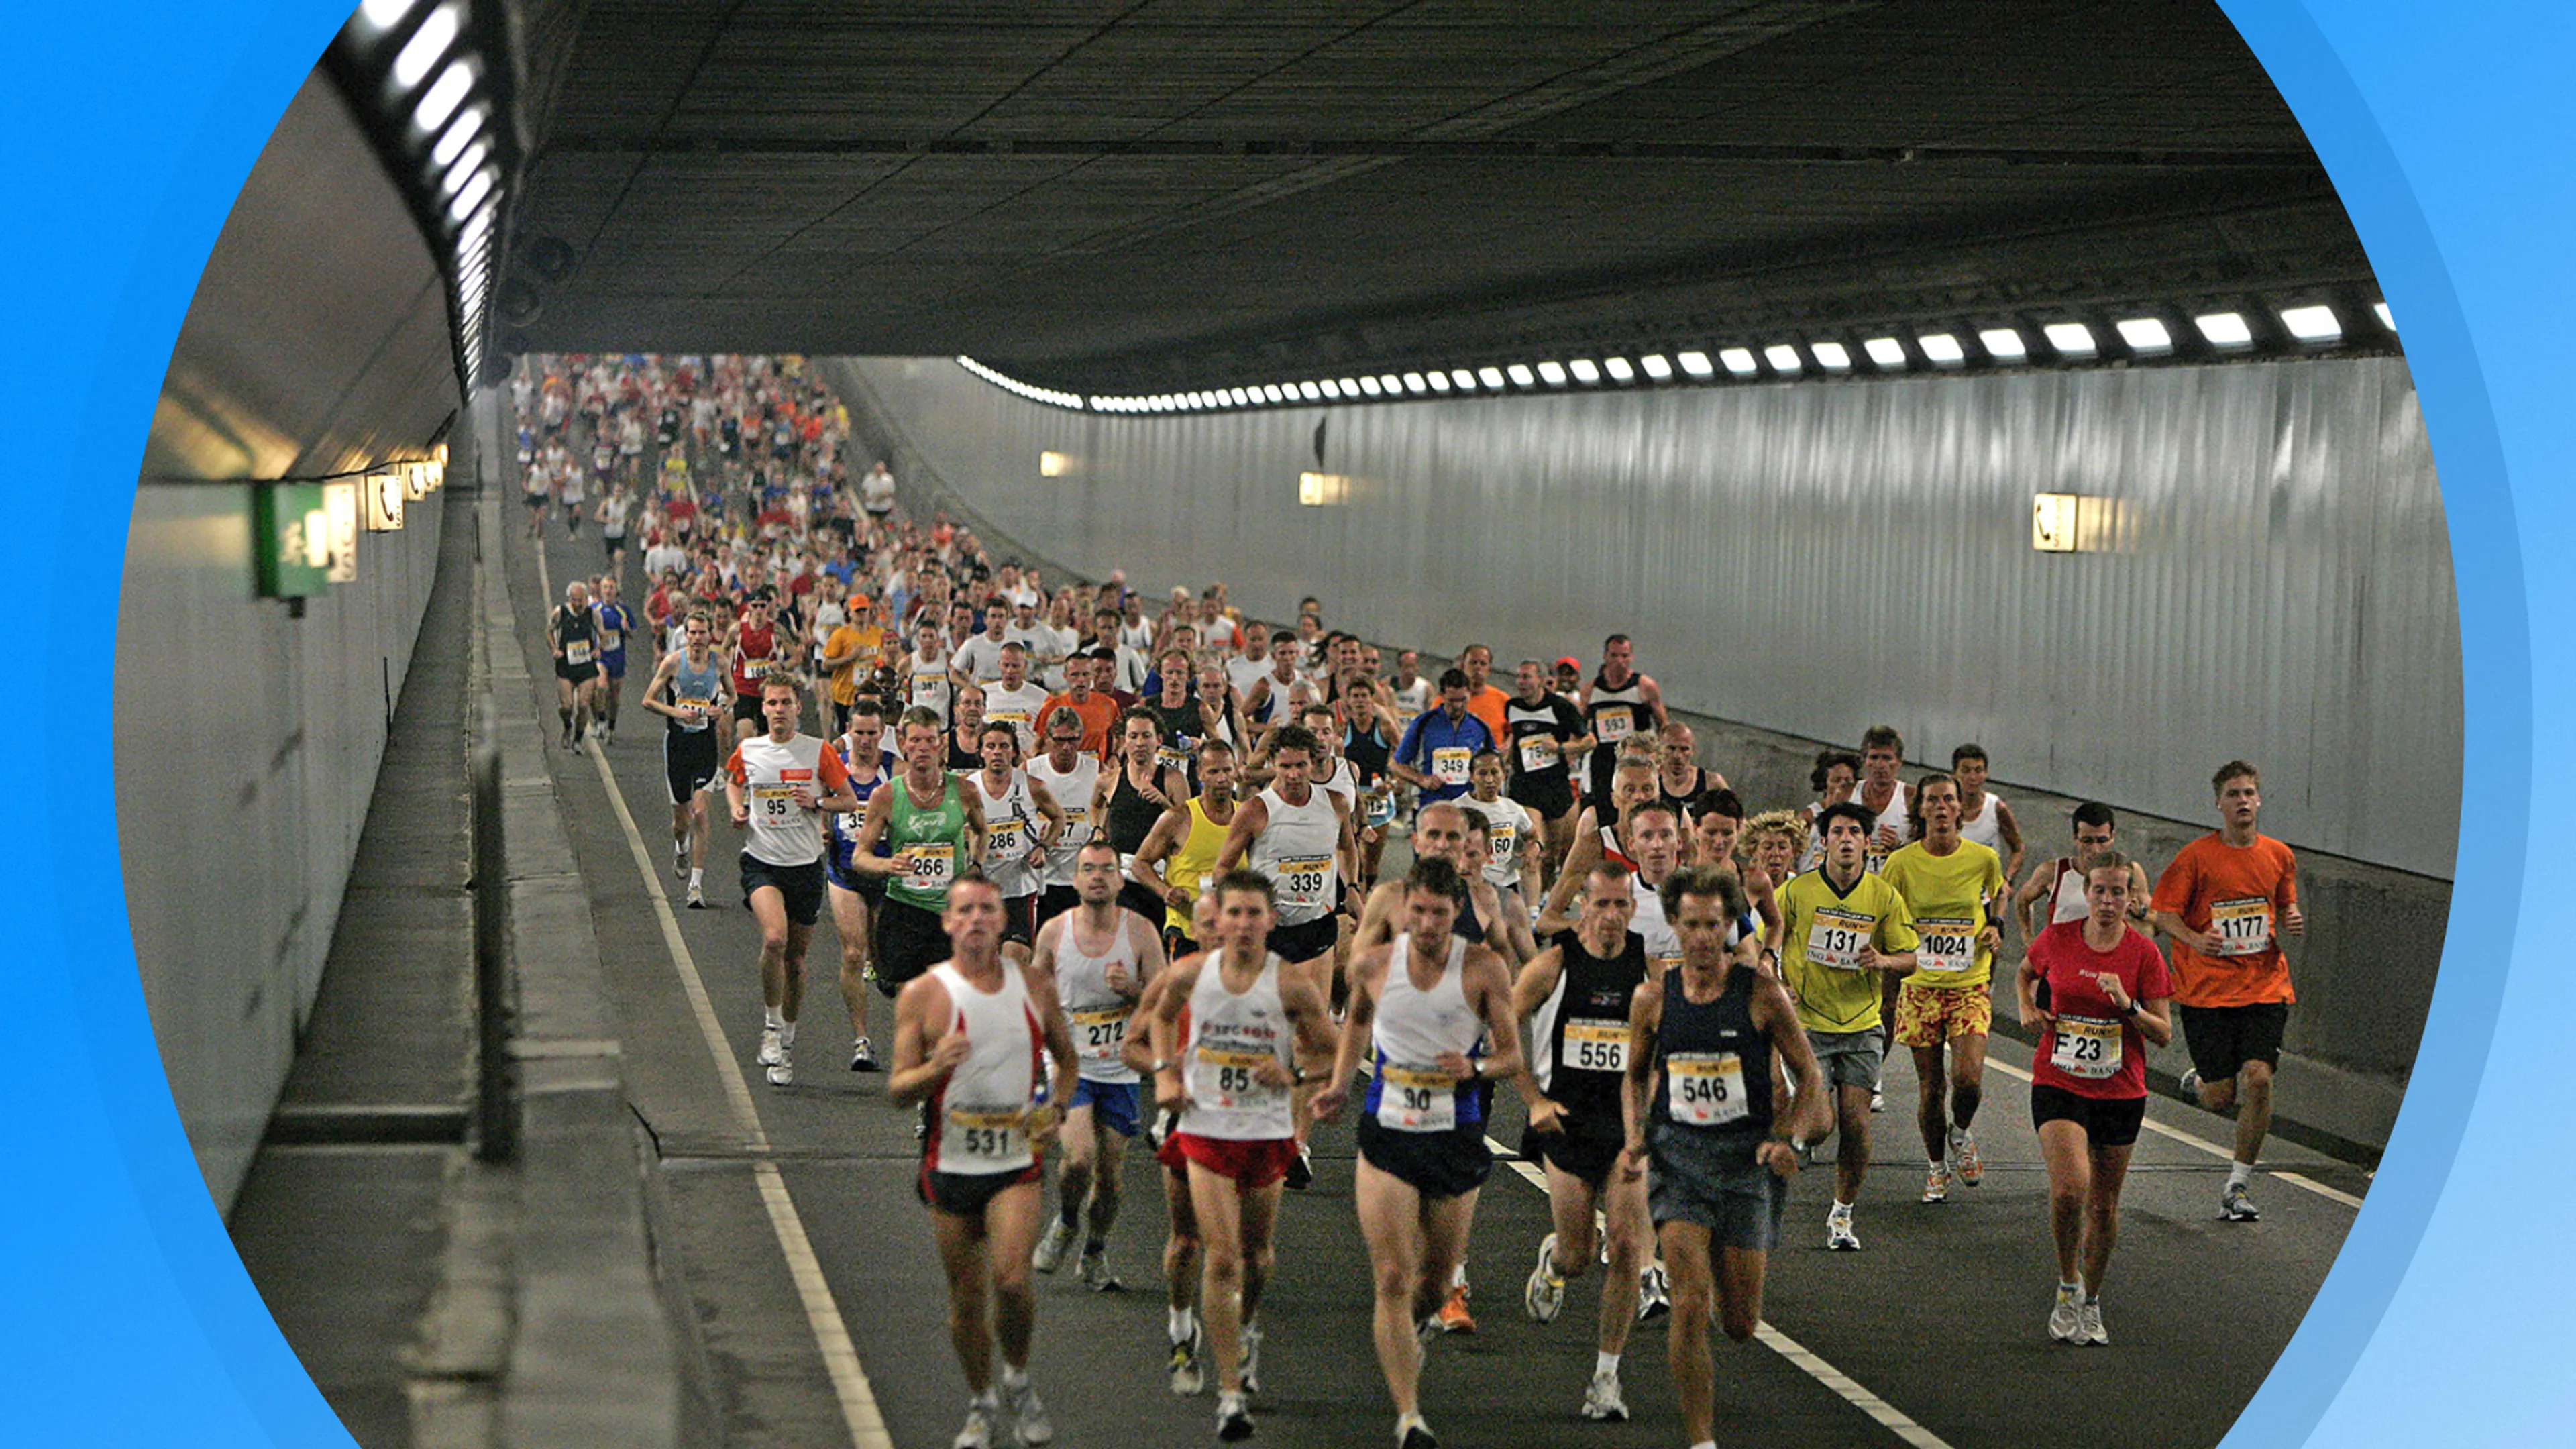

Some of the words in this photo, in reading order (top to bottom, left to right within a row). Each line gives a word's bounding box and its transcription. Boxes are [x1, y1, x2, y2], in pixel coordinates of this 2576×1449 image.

[1441, 759, 1464, 773] 349
[767, 799, 786, 814] 95
[989, 832, 1016, 849] 286
[913, 858, 944, 876] 266
[1290, 873, 1322, 892] 339
[1838, 919, 1859, 929] RUN
[2222, 916, 2263, 938] 1177
[1825, 928, 1857, 953] 131
[1925, 934, 1967, 956] 1024
[1088, 1020, 1124, 1046] 272
[2083, 1026, 2106, 1036] RUN
[1580, 1041, 1621, 1069] 556
[2054, 1033, 2070, 1054] F
[2074, 1036, 2101, 1061] 23
[1220, 1067, 1249, 1093] 85
[1682, 1076, 1727, 1103] 546
[1403, 1087, 1432, 1112] 90
[965, 1128, 1009, 1155] 531
